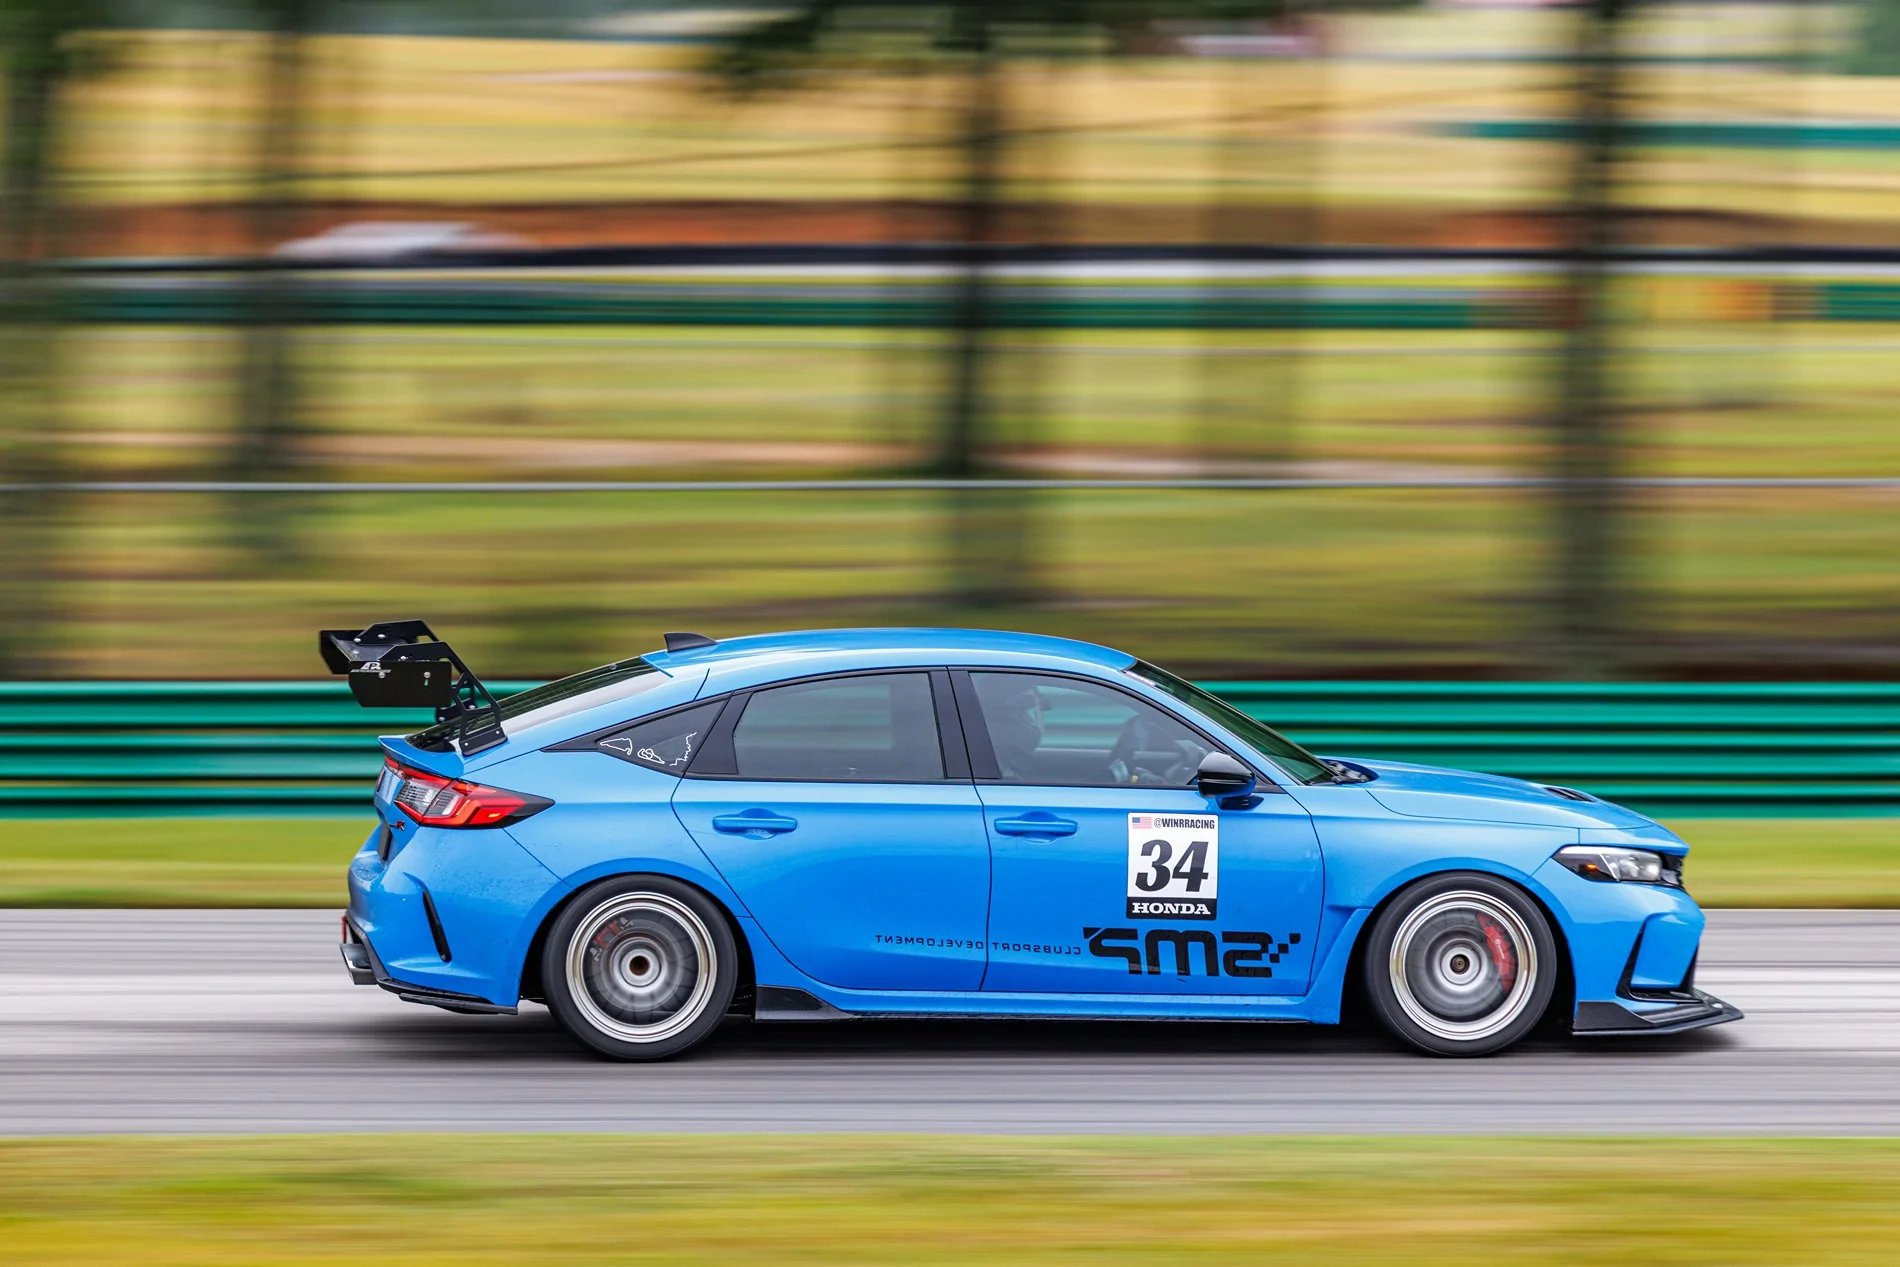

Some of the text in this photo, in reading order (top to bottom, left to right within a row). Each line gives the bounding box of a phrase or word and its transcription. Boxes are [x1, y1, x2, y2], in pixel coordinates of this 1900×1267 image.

[1153, 817, 1215, 830] @WINRRACING
[1135, 839, 1210, 892] 34
[1132, 902, 1211, 915] HONDA
